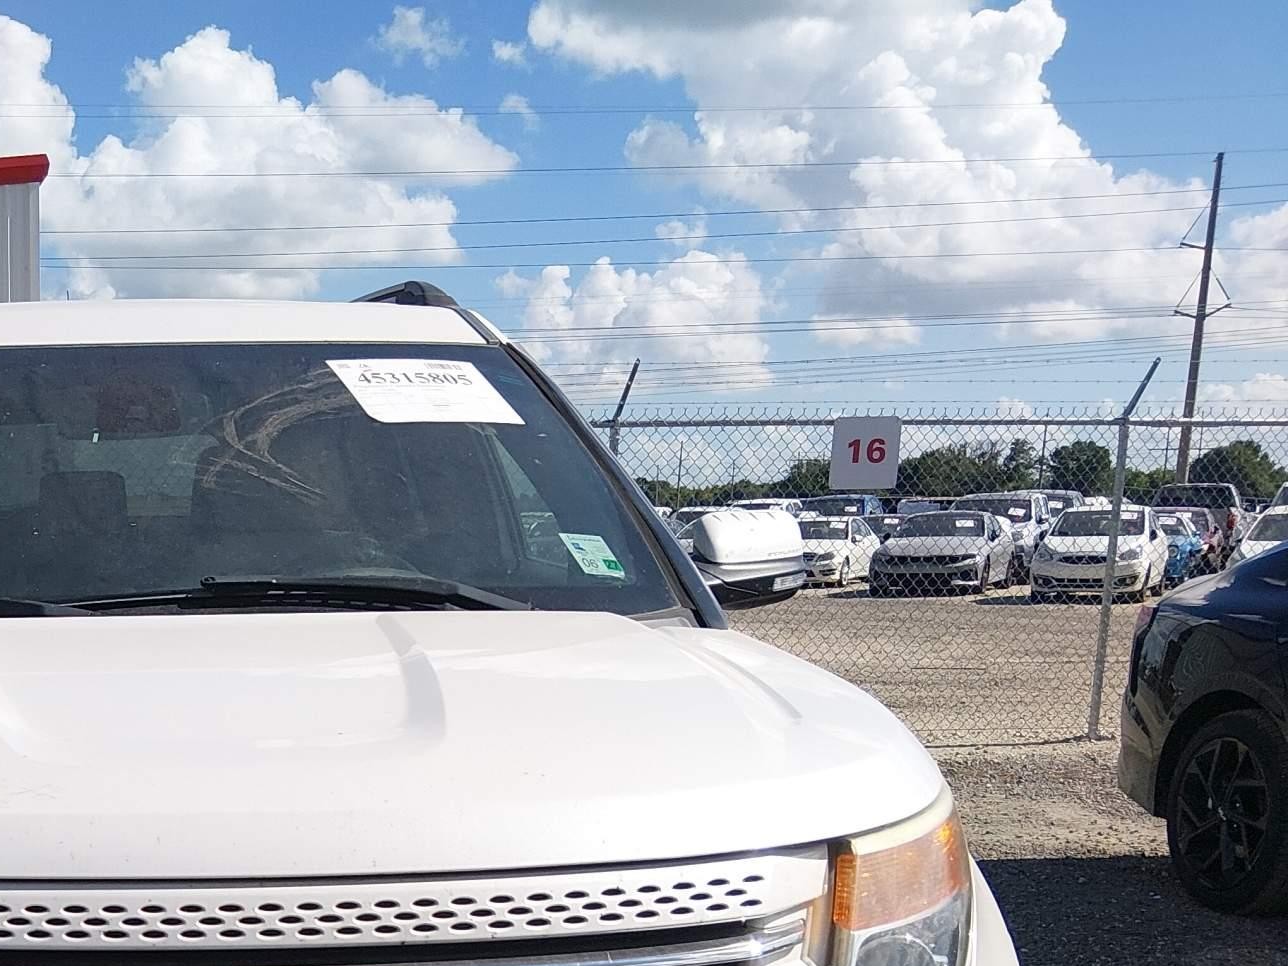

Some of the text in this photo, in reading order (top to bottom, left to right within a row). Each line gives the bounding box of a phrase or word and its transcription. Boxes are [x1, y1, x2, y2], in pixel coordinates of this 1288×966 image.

[357, 371, 473, 386] 45315805
[848, 438, 886, 464] 16
[582, 557, 599, 569] 06
